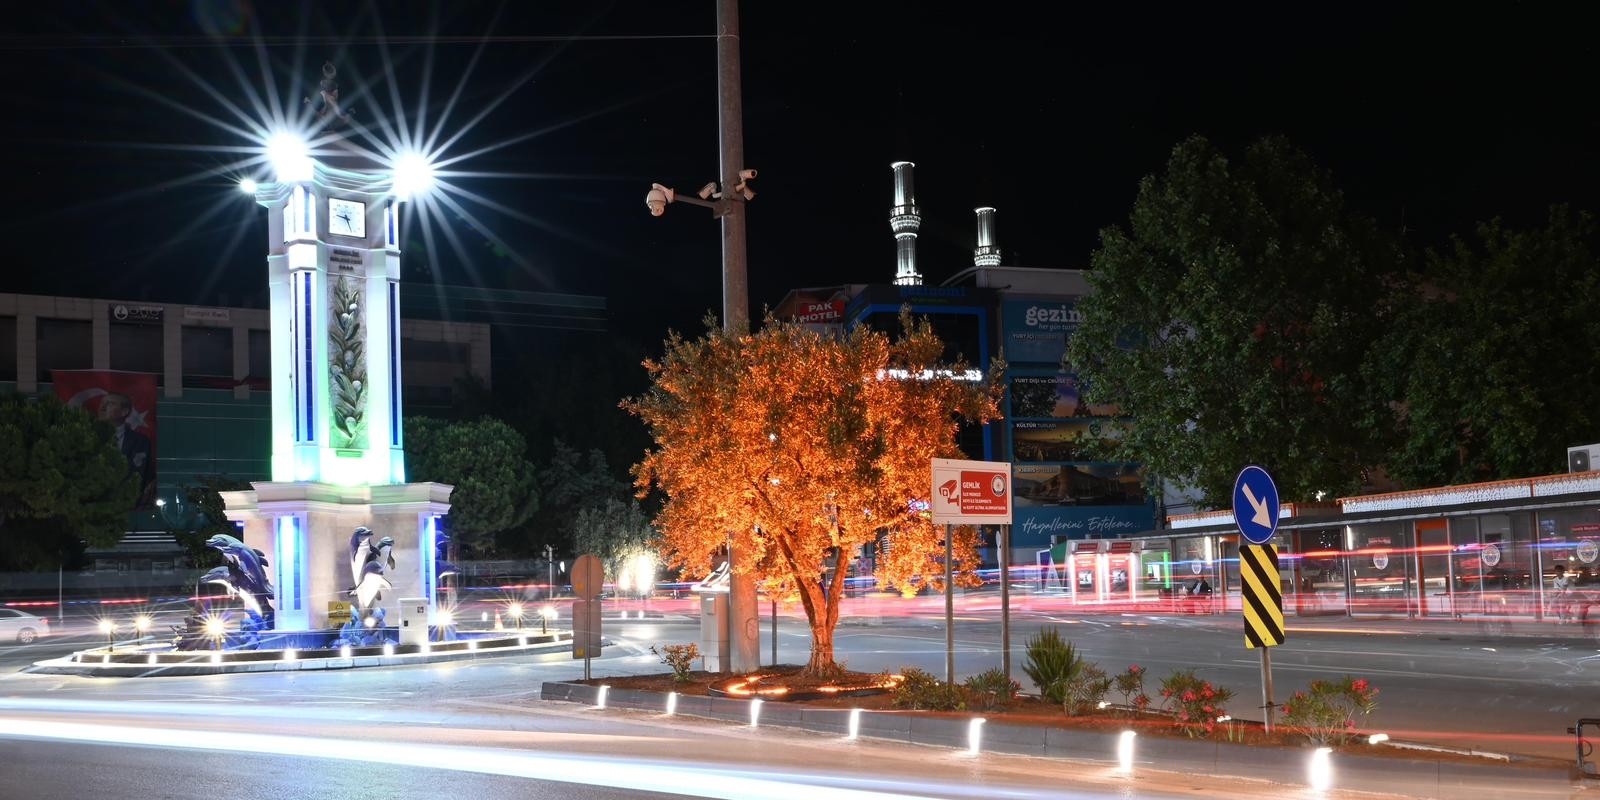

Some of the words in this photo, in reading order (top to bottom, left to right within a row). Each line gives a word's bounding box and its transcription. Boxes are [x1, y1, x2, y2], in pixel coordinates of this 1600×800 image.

[808, 302, 832, 312] PAK
[800, 312, 841, 323] HOTEL
[1025, 305, 1082, 326] gezin
[962, 481, 981, 489] GEMLİK
